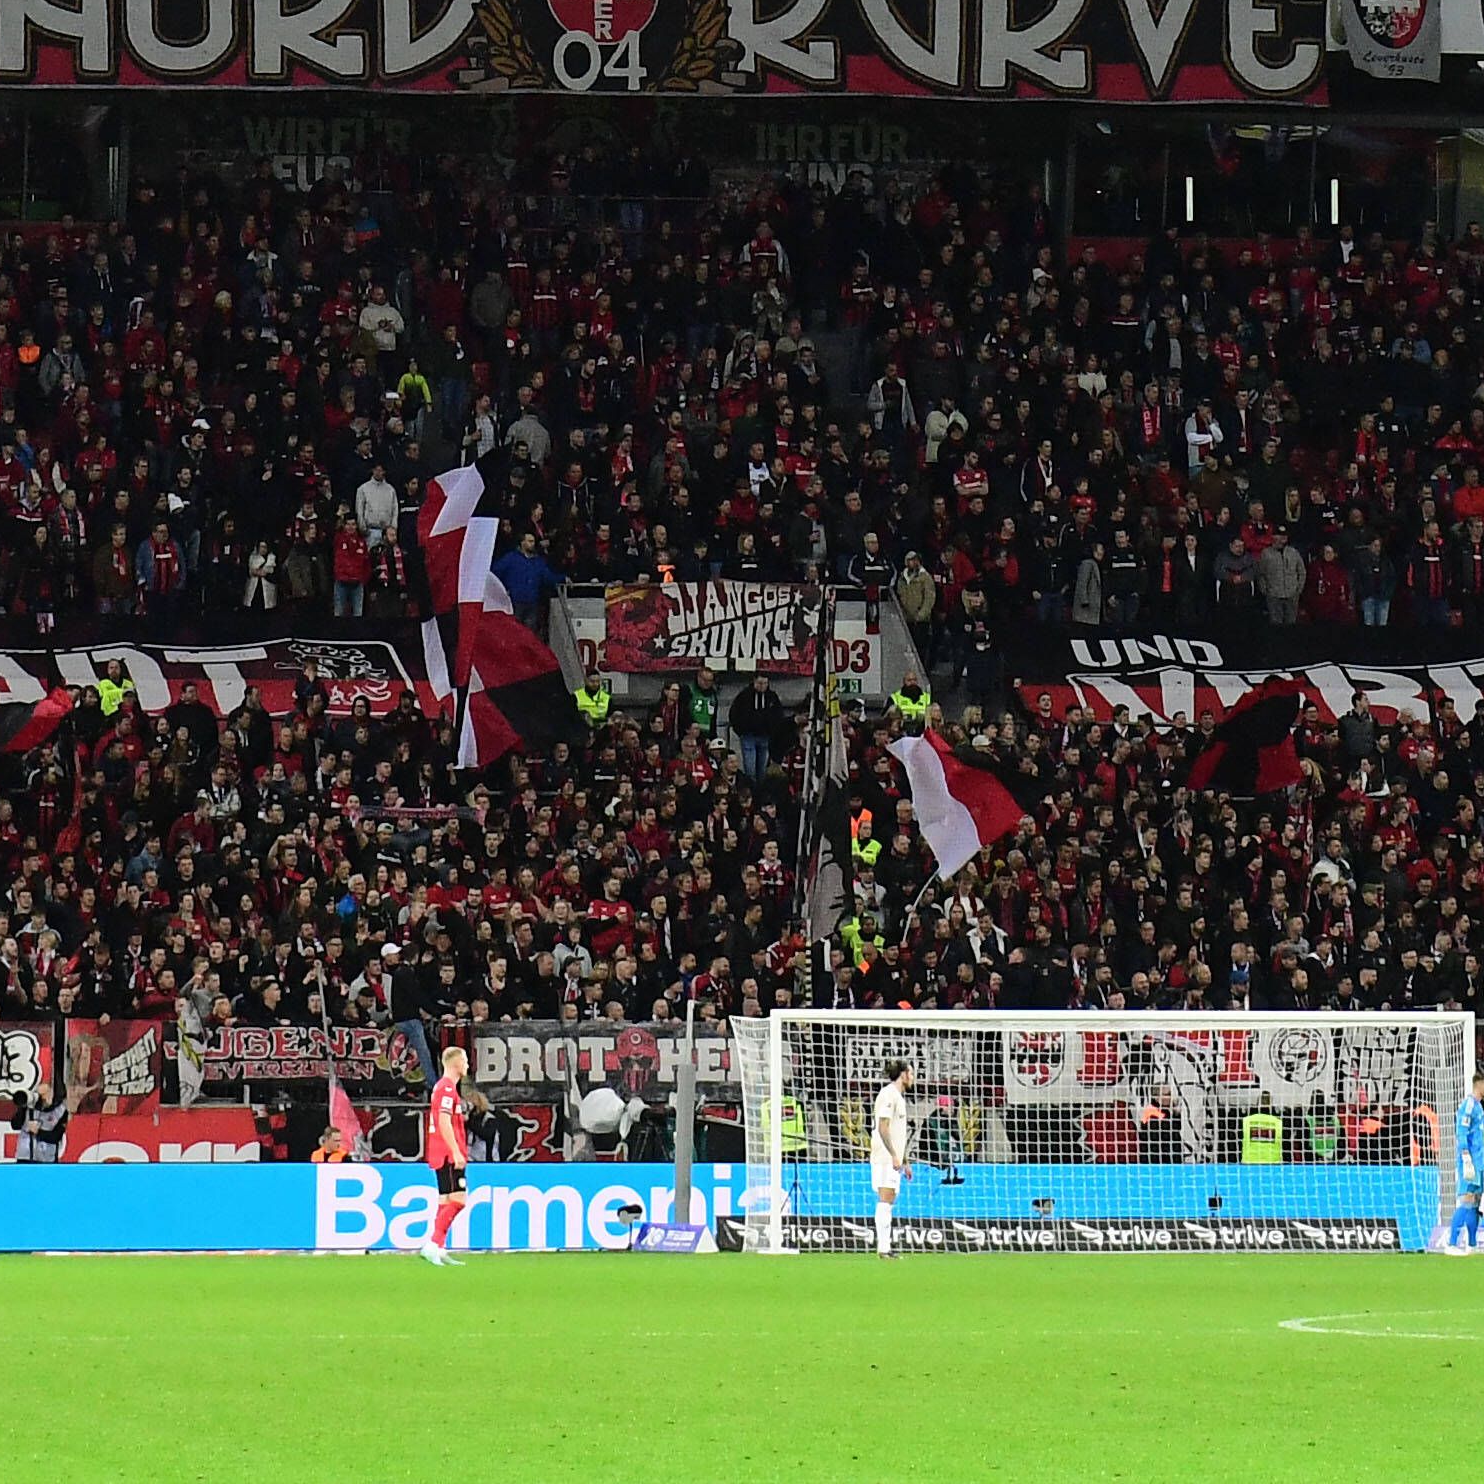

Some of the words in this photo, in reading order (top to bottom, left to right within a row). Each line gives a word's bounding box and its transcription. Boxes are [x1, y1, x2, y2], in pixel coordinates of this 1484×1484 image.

[552, 30, 648, 92] 04
[754, 121, 828, 162] IHR
[1069, 633, 1224, 669] UND
[202, 1060, 375, 1082] EVERKUSEN
[779, 1225, 829, 1244] rive
[890, 1224, 944, 1244] rive
[990, 1224, 1055, 1245] trive
[1108, 1224, 1172, 1246] trive
[1220, 1224, 1286, 1246] trive
[1329, 1224, 1396, 1246] trive
